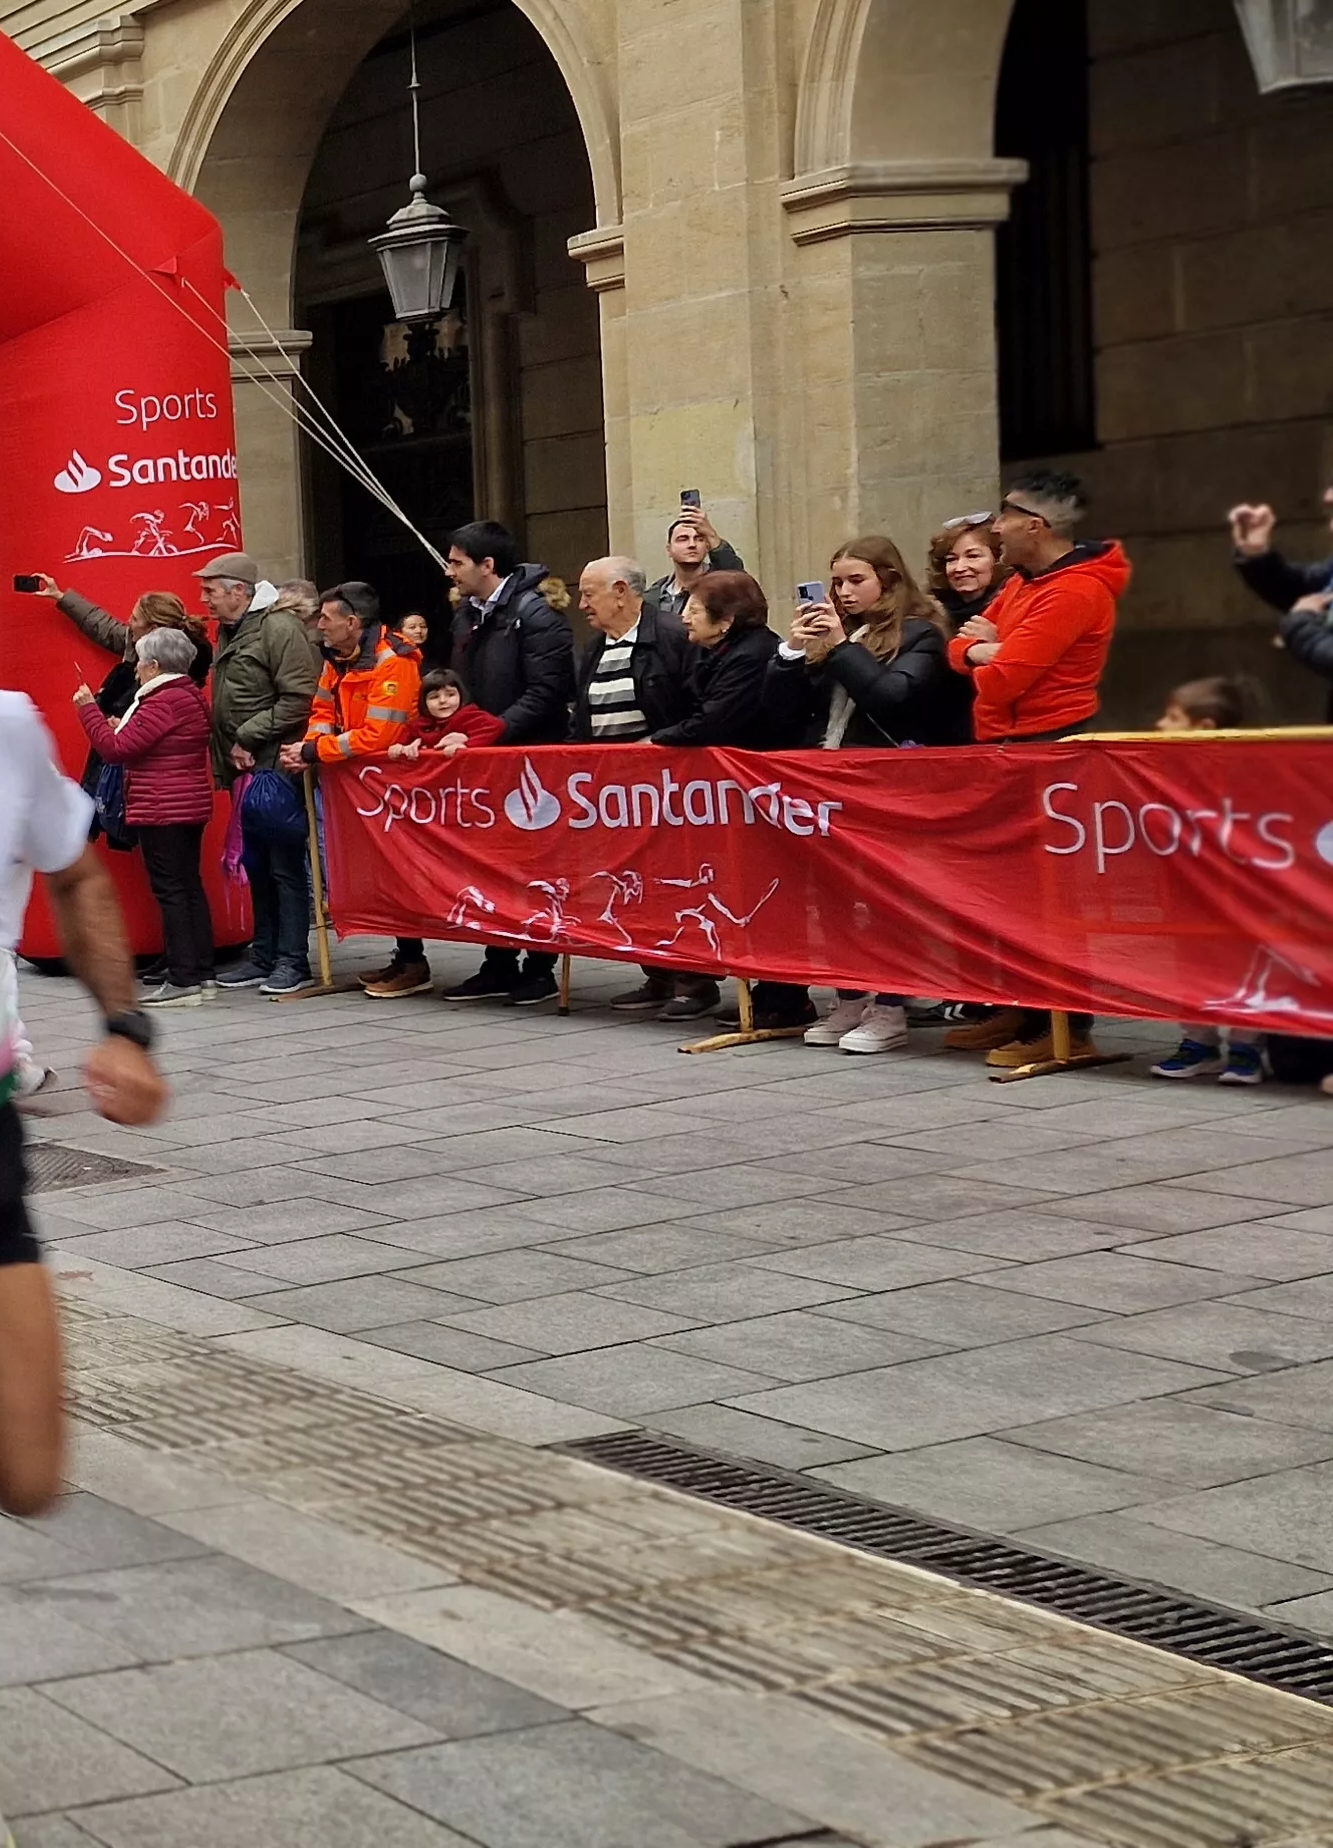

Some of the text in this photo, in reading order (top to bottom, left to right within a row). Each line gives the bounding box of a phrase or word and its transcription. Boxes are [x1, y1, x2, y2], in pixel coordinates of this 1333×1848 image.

[114, 387, 218, 431] Sports
[108, 447, 238, 487] Santande
[356, 765, 496, 832] Sports
[1042, 782, 1295, 875] Sports
